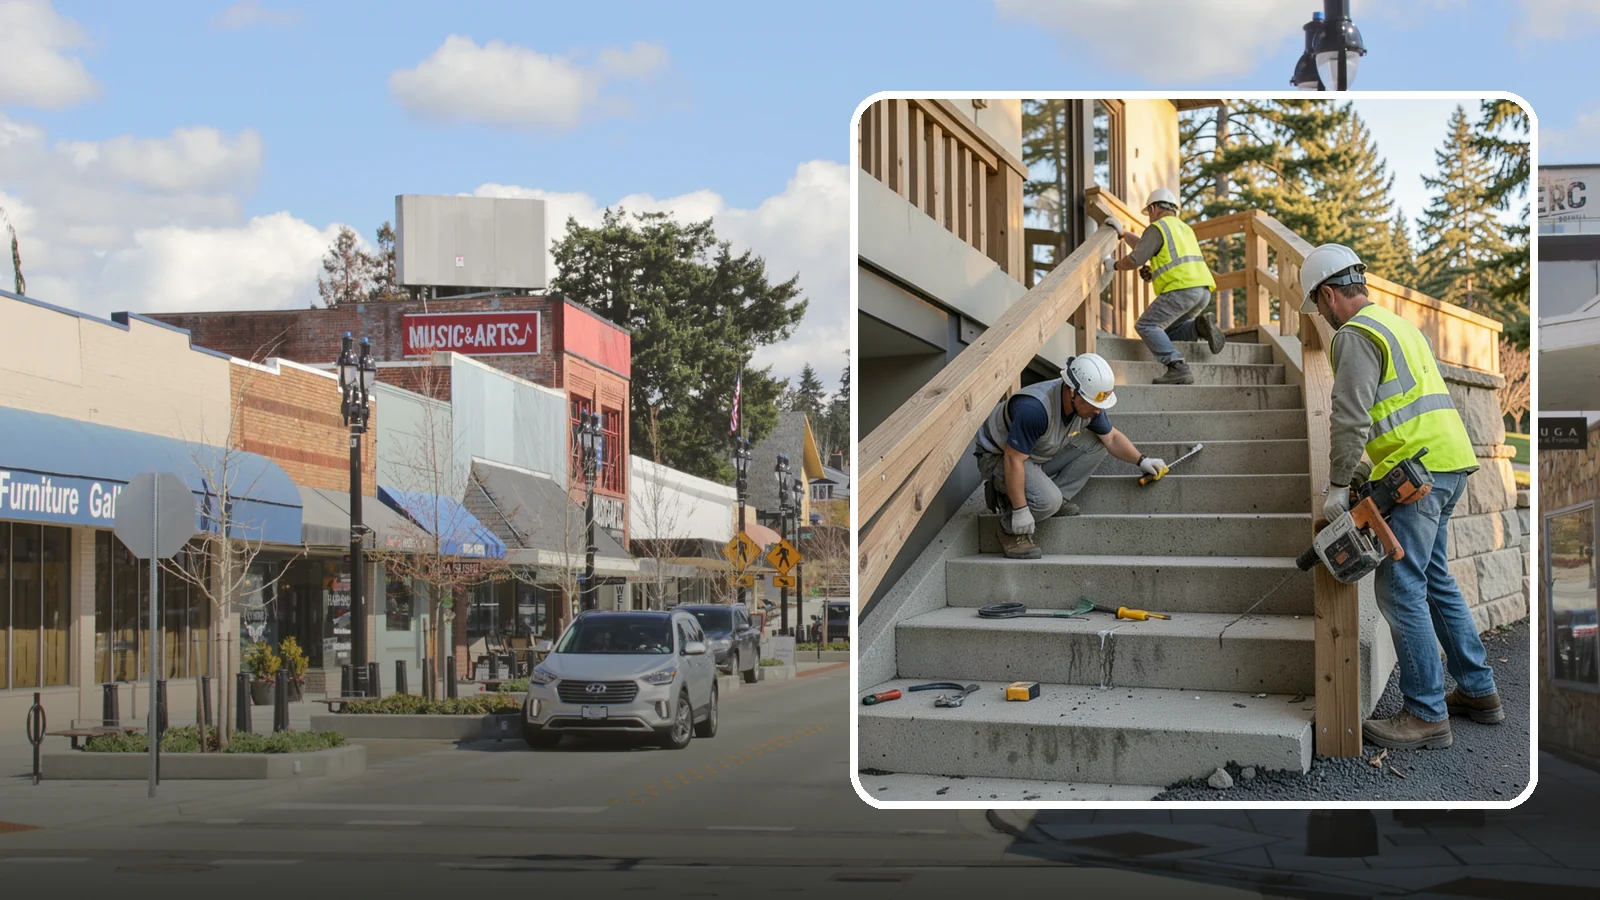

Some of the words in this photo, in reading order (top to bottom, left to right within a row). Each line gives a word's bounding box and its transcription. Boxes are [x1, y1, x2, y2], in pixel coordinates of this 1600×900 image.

[408, 323, 519, 349] MUSIC&ARTS
[0, 471, 79, 515] Furniture
[89, 482, 122, 519] Gal
[454, 563, 480, 574] SUSHI
